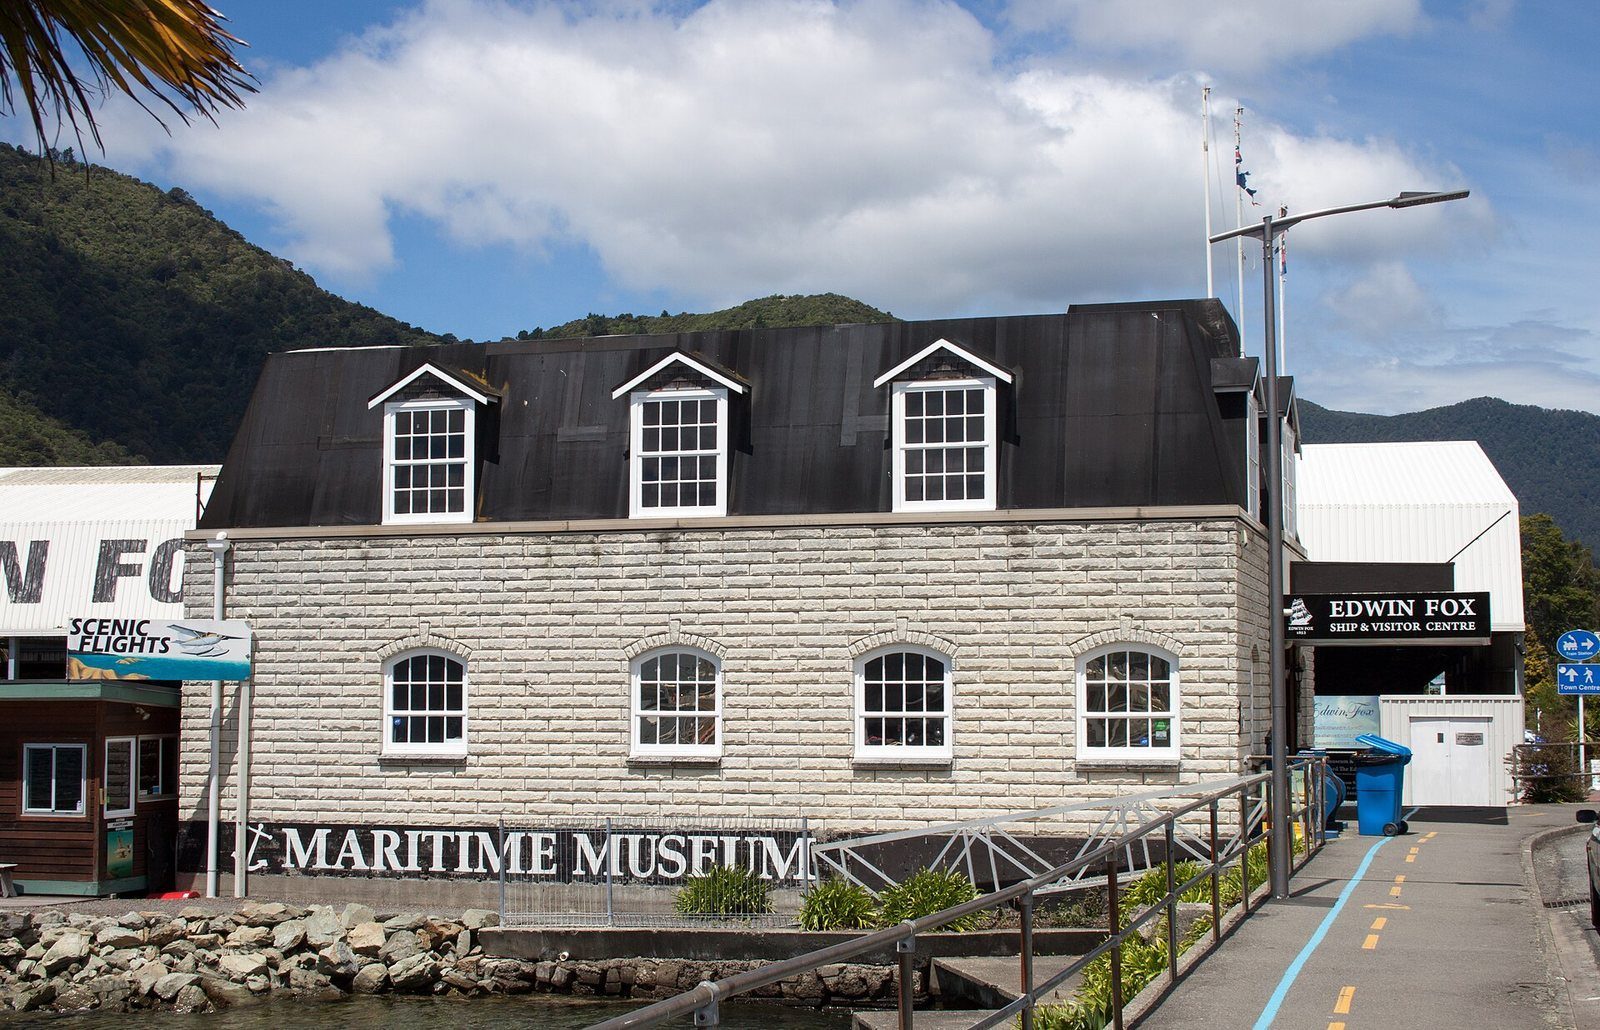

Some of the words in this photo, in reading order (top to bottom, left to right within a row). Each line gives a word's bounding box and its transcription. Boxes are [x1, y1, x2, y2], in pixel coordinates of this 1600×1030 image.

[1329, 599, 1415, 618] EDWIN
[1424, 598, 1477, 617] FOX
[70, 618, 150, 636] SCENIC
[1330, 622, 1357, 632] SHIP
[1360, 622, 1369, 632] &
[1370, 621, 1422, 632] VISITOR
[1425, 621, 1476, 631] CENTRE
[79, 635, 171, 654] FLIGHTS
[1346, 701, 1374, 719] Fox
[281, 827, 557, 875] MARITIME
[572, 833, 817, 880] MUSEUM
